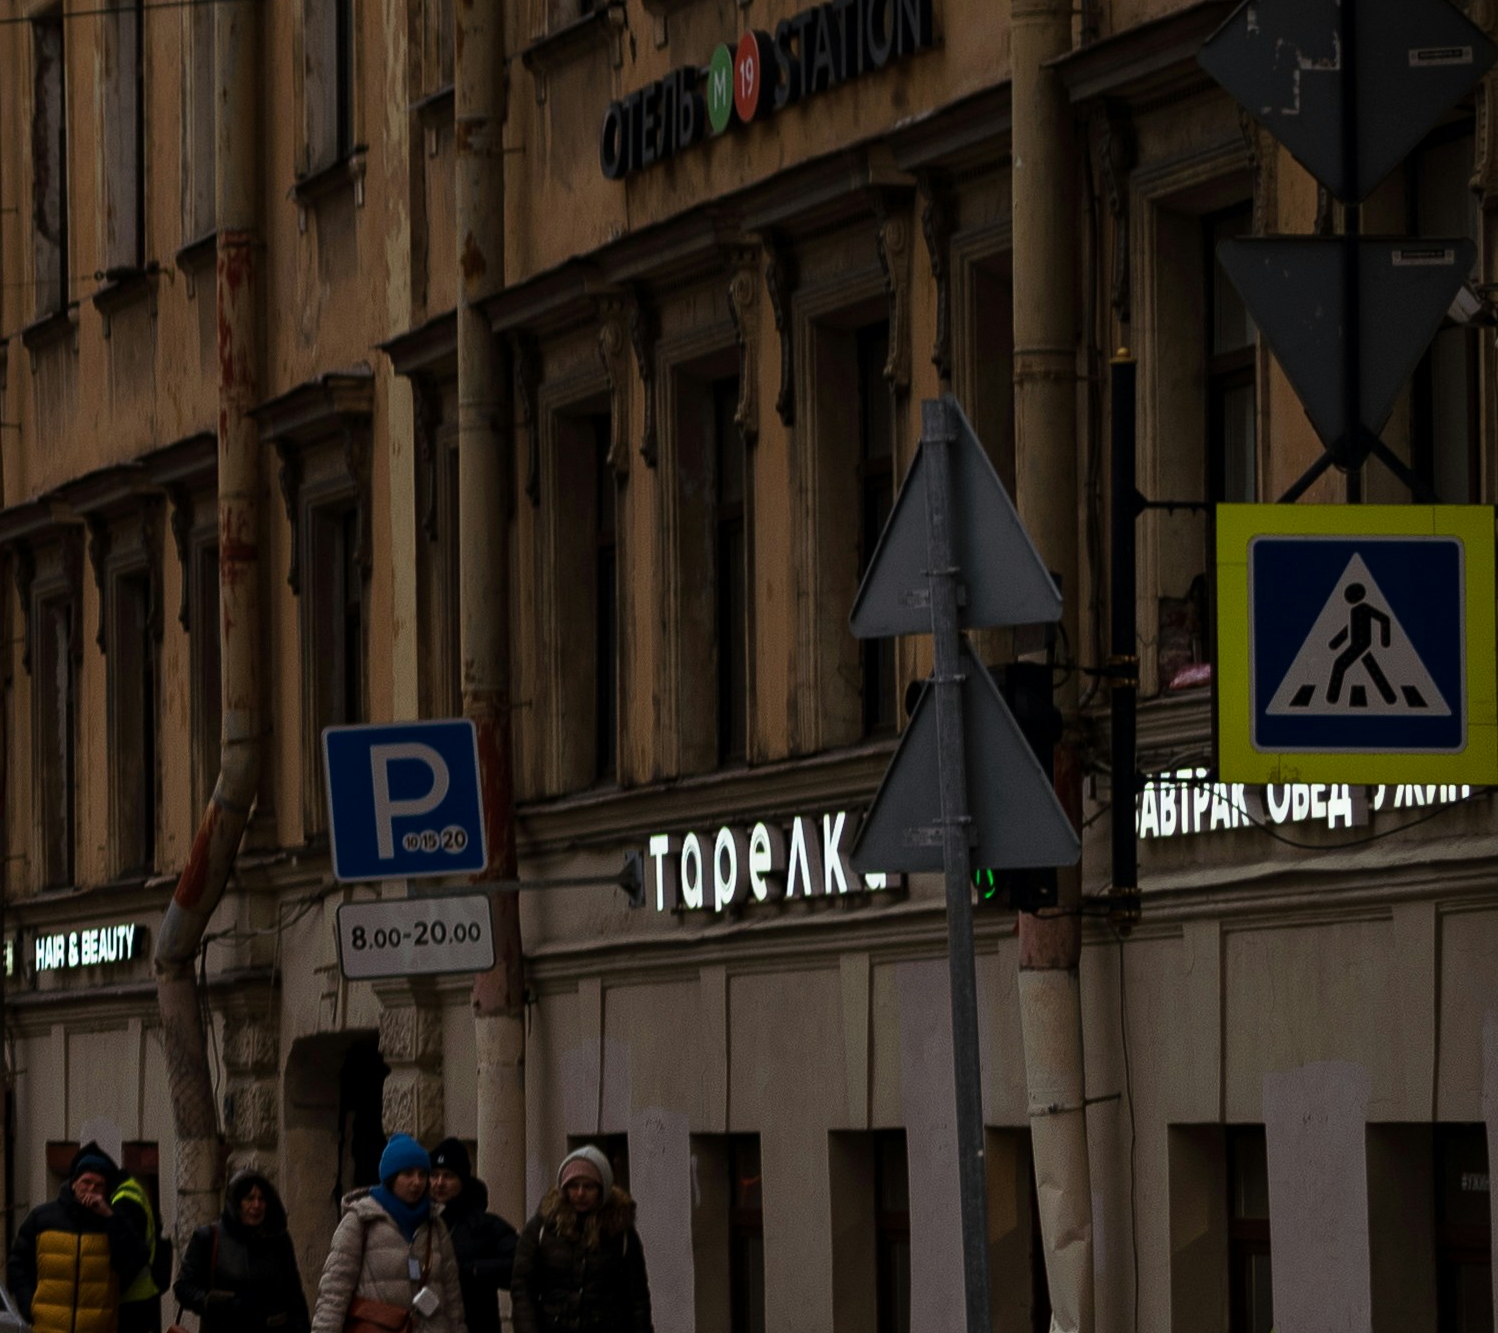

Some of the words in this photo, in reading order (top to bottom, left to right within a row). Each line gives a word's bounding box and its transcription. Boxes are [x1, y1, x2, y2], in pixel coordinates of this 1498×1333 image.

[600, 69, 695, 180] ОТЕЛЬ
[739, 54, 754, 97] 19
[369, 741, 451, 860] P
[443, 832, 467, 849] 20
[1136, 768, 1250, 839] АВТРАК
[649, 811, 887, 913] тарелк
[35, 933, 65, 972] HAIR
[68, 931, 79, 968] &
[81, 922, 135, 966] BEAUTY
